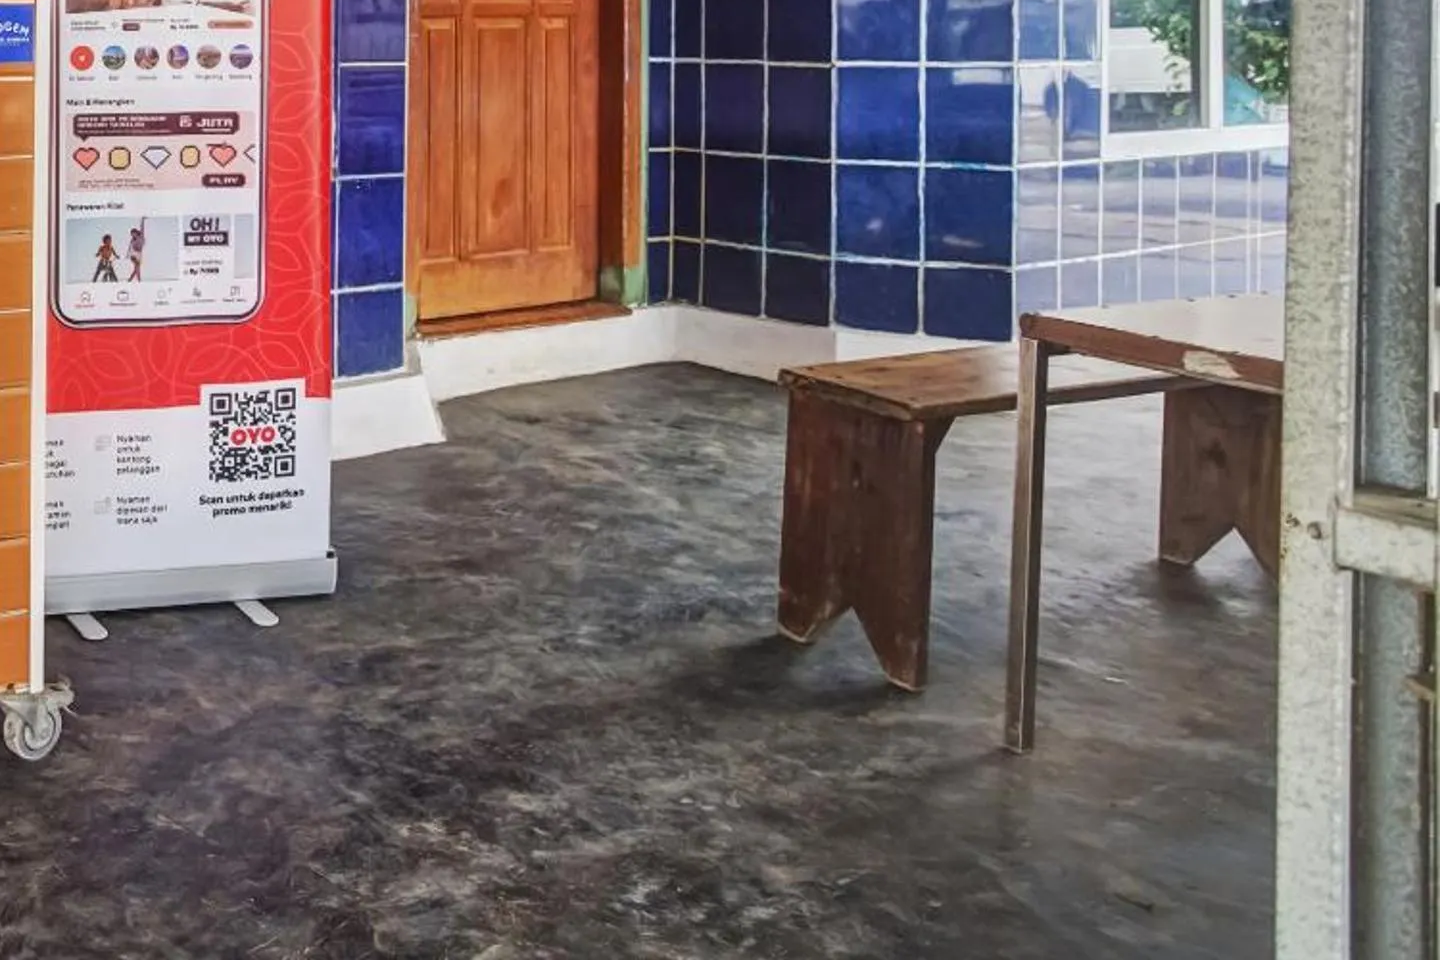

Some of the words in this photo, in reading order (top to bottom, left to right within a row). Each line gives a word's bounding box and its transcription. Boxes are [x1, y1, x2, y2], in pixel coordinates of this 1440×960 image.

[231, 426, 276, 446] OYO
[199, 494, 224, 506] Scan
[226, 492, 256, 504] untuk
[212, 506, 247, 519] promo
